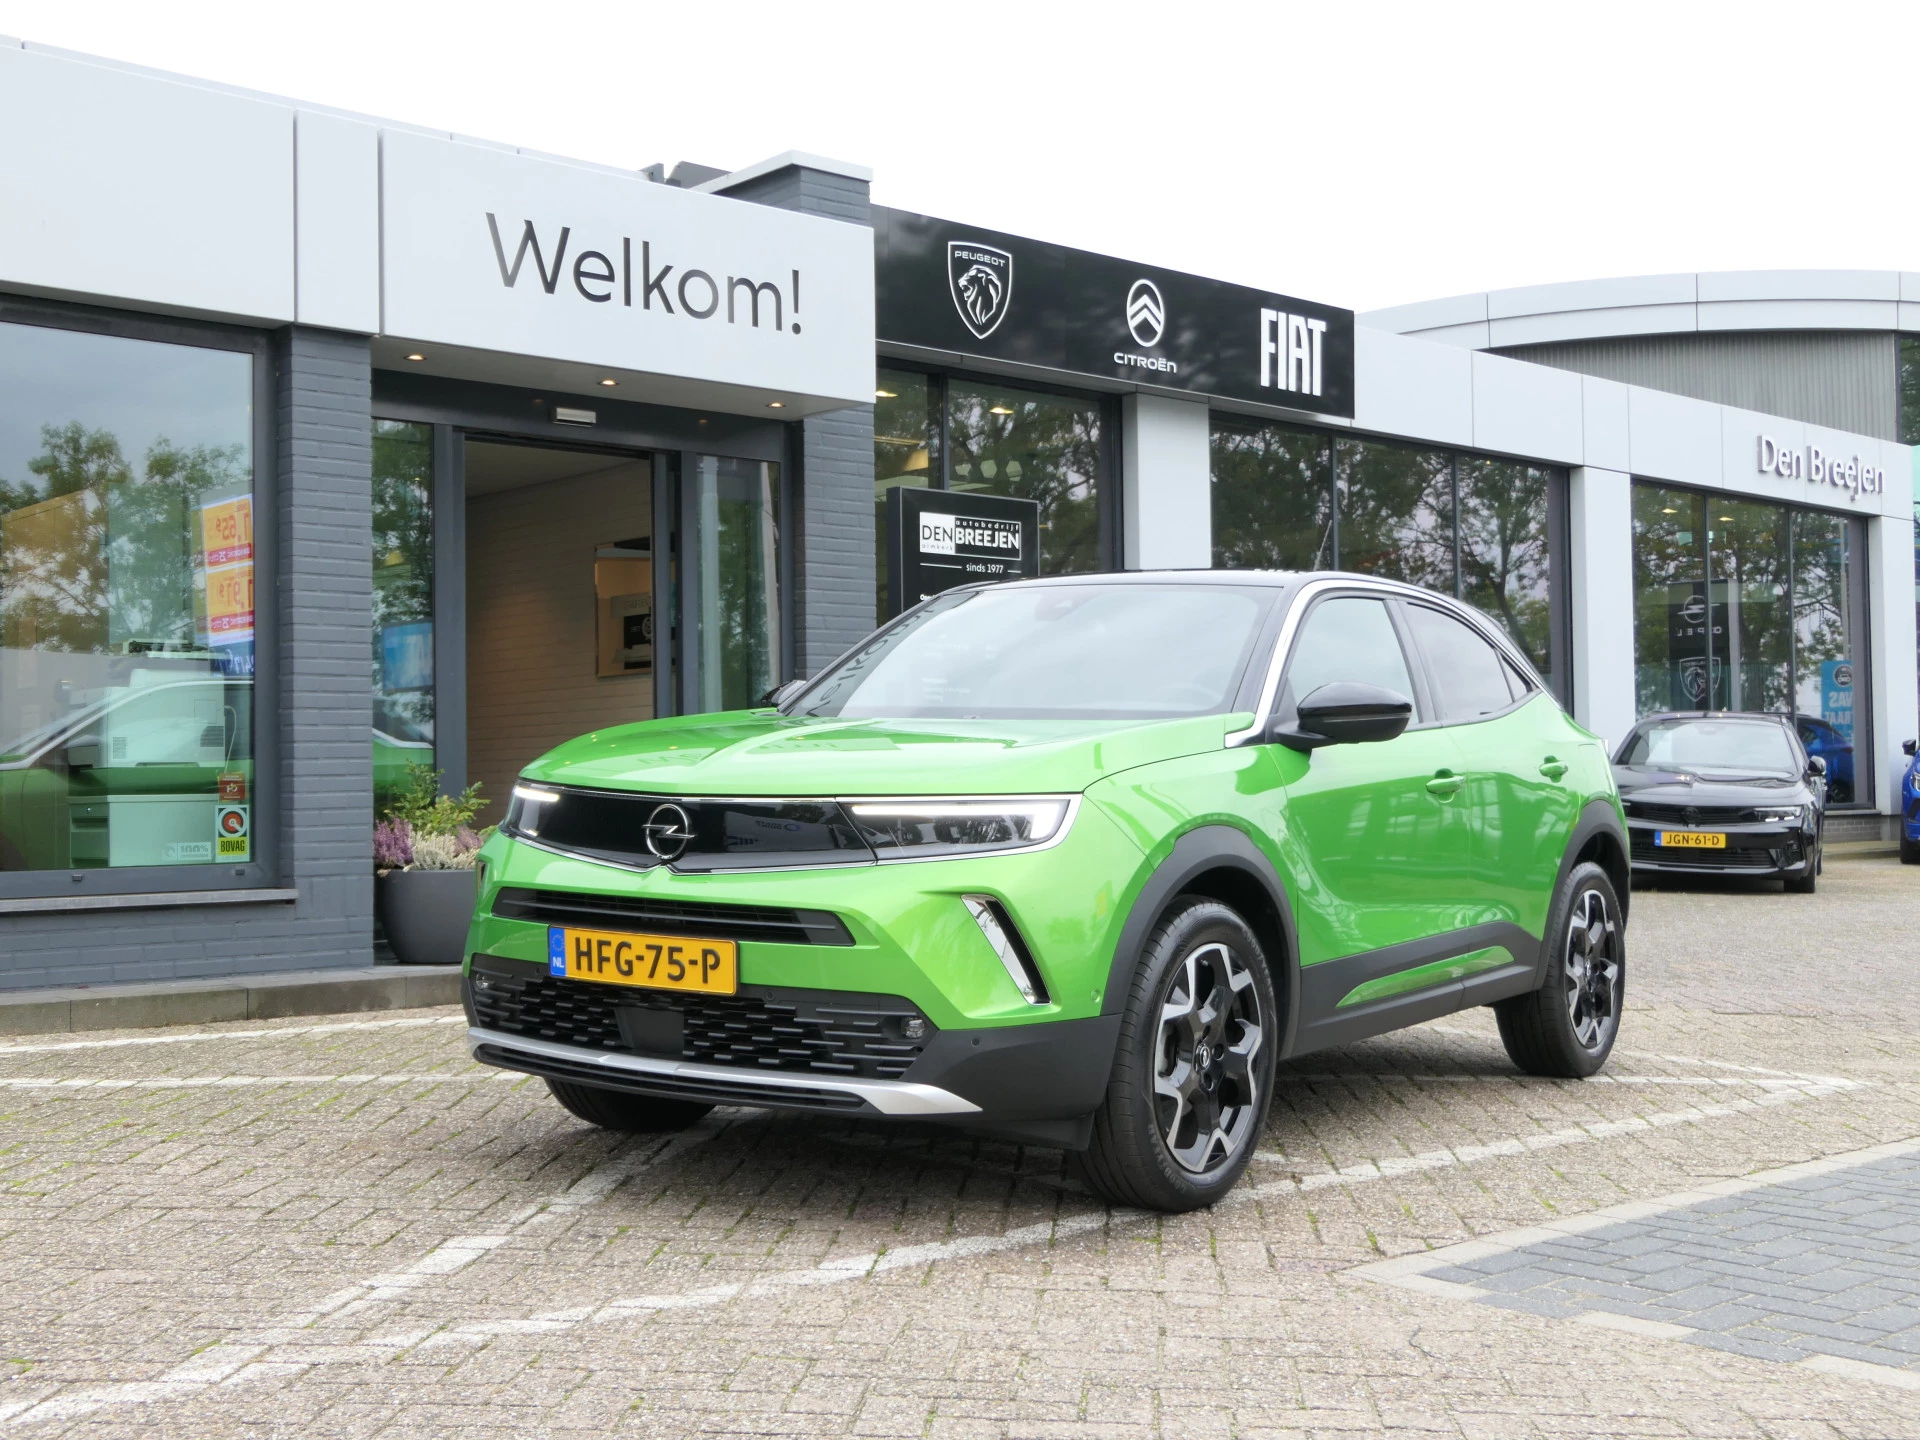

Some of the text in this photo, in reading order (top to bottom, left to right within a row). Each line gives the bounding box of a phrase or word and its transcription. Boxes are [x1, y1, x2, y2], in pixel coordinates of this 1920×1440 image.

[954, 250, 1006, 268] PEUGEOT
[485, 211, 802, 335] Welkom!
[1260, 307, 1327, 397] FIAT
[1757, 434, 1886, 501] Den Breejen
[955, 519, 1020, 532] autobedrijf
[922, 525, 1020, 549] DEN BREEJEN
[966, 562, 1004, 574] sinds 1977
[220, 840, 245, 853] BOVAG
[1666, 834, 1720, 846] JGN-61-D
[552, 936, 721, 984] NL HFG-75-P
